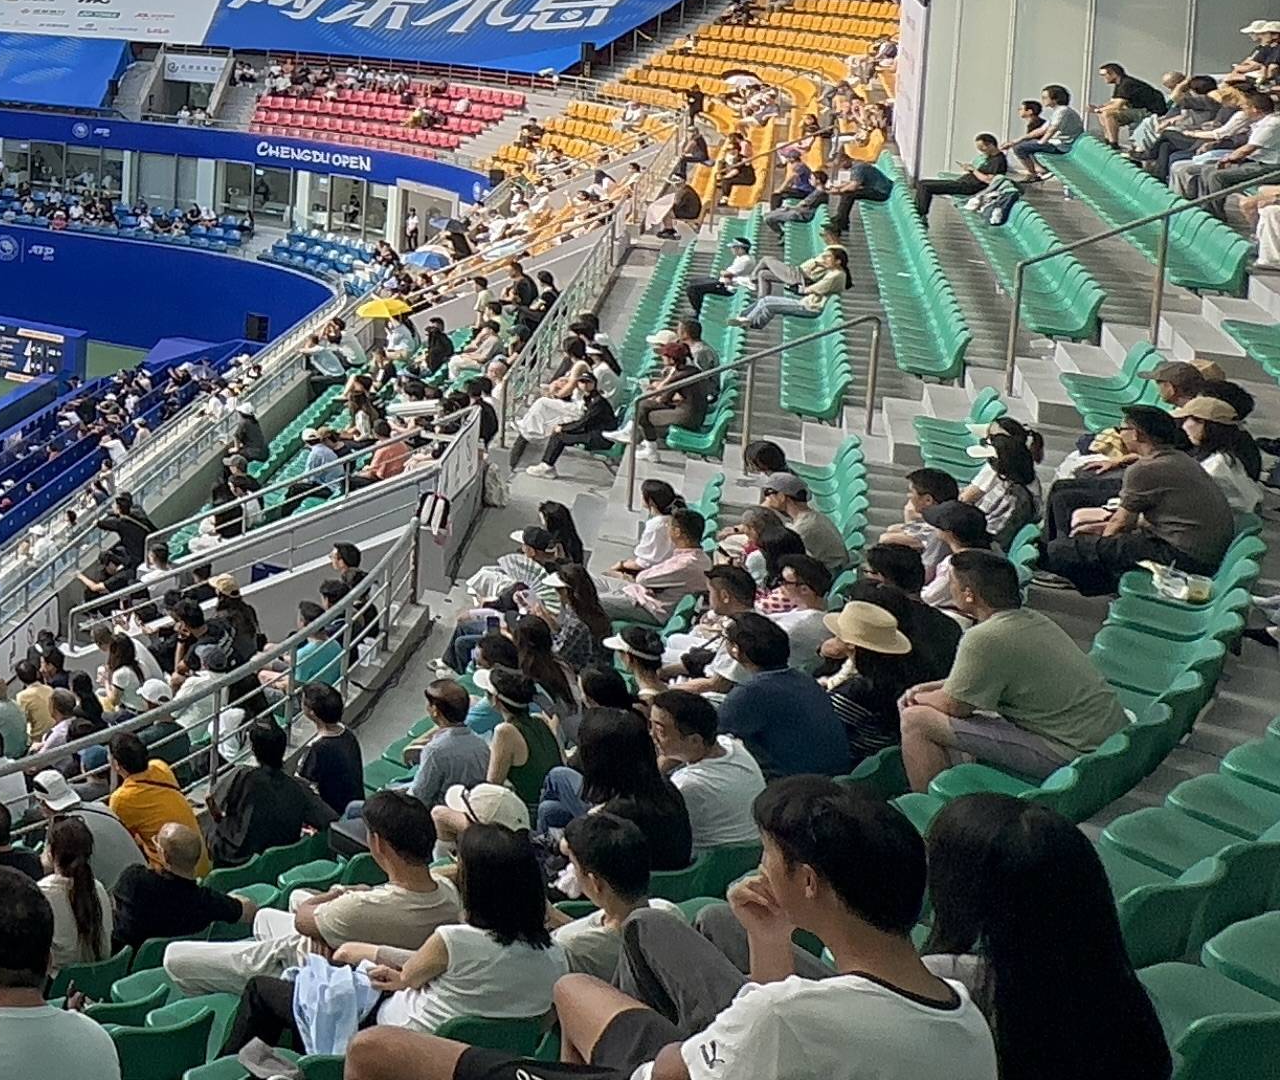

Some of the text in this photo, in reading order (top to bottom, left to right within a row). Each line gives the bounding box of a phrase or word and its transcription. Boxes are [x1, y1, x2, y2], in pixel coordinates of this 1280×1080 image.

[256, 141, 371, 171] CHENGDU OPEN
[28, 245, 55, 256] ATP
